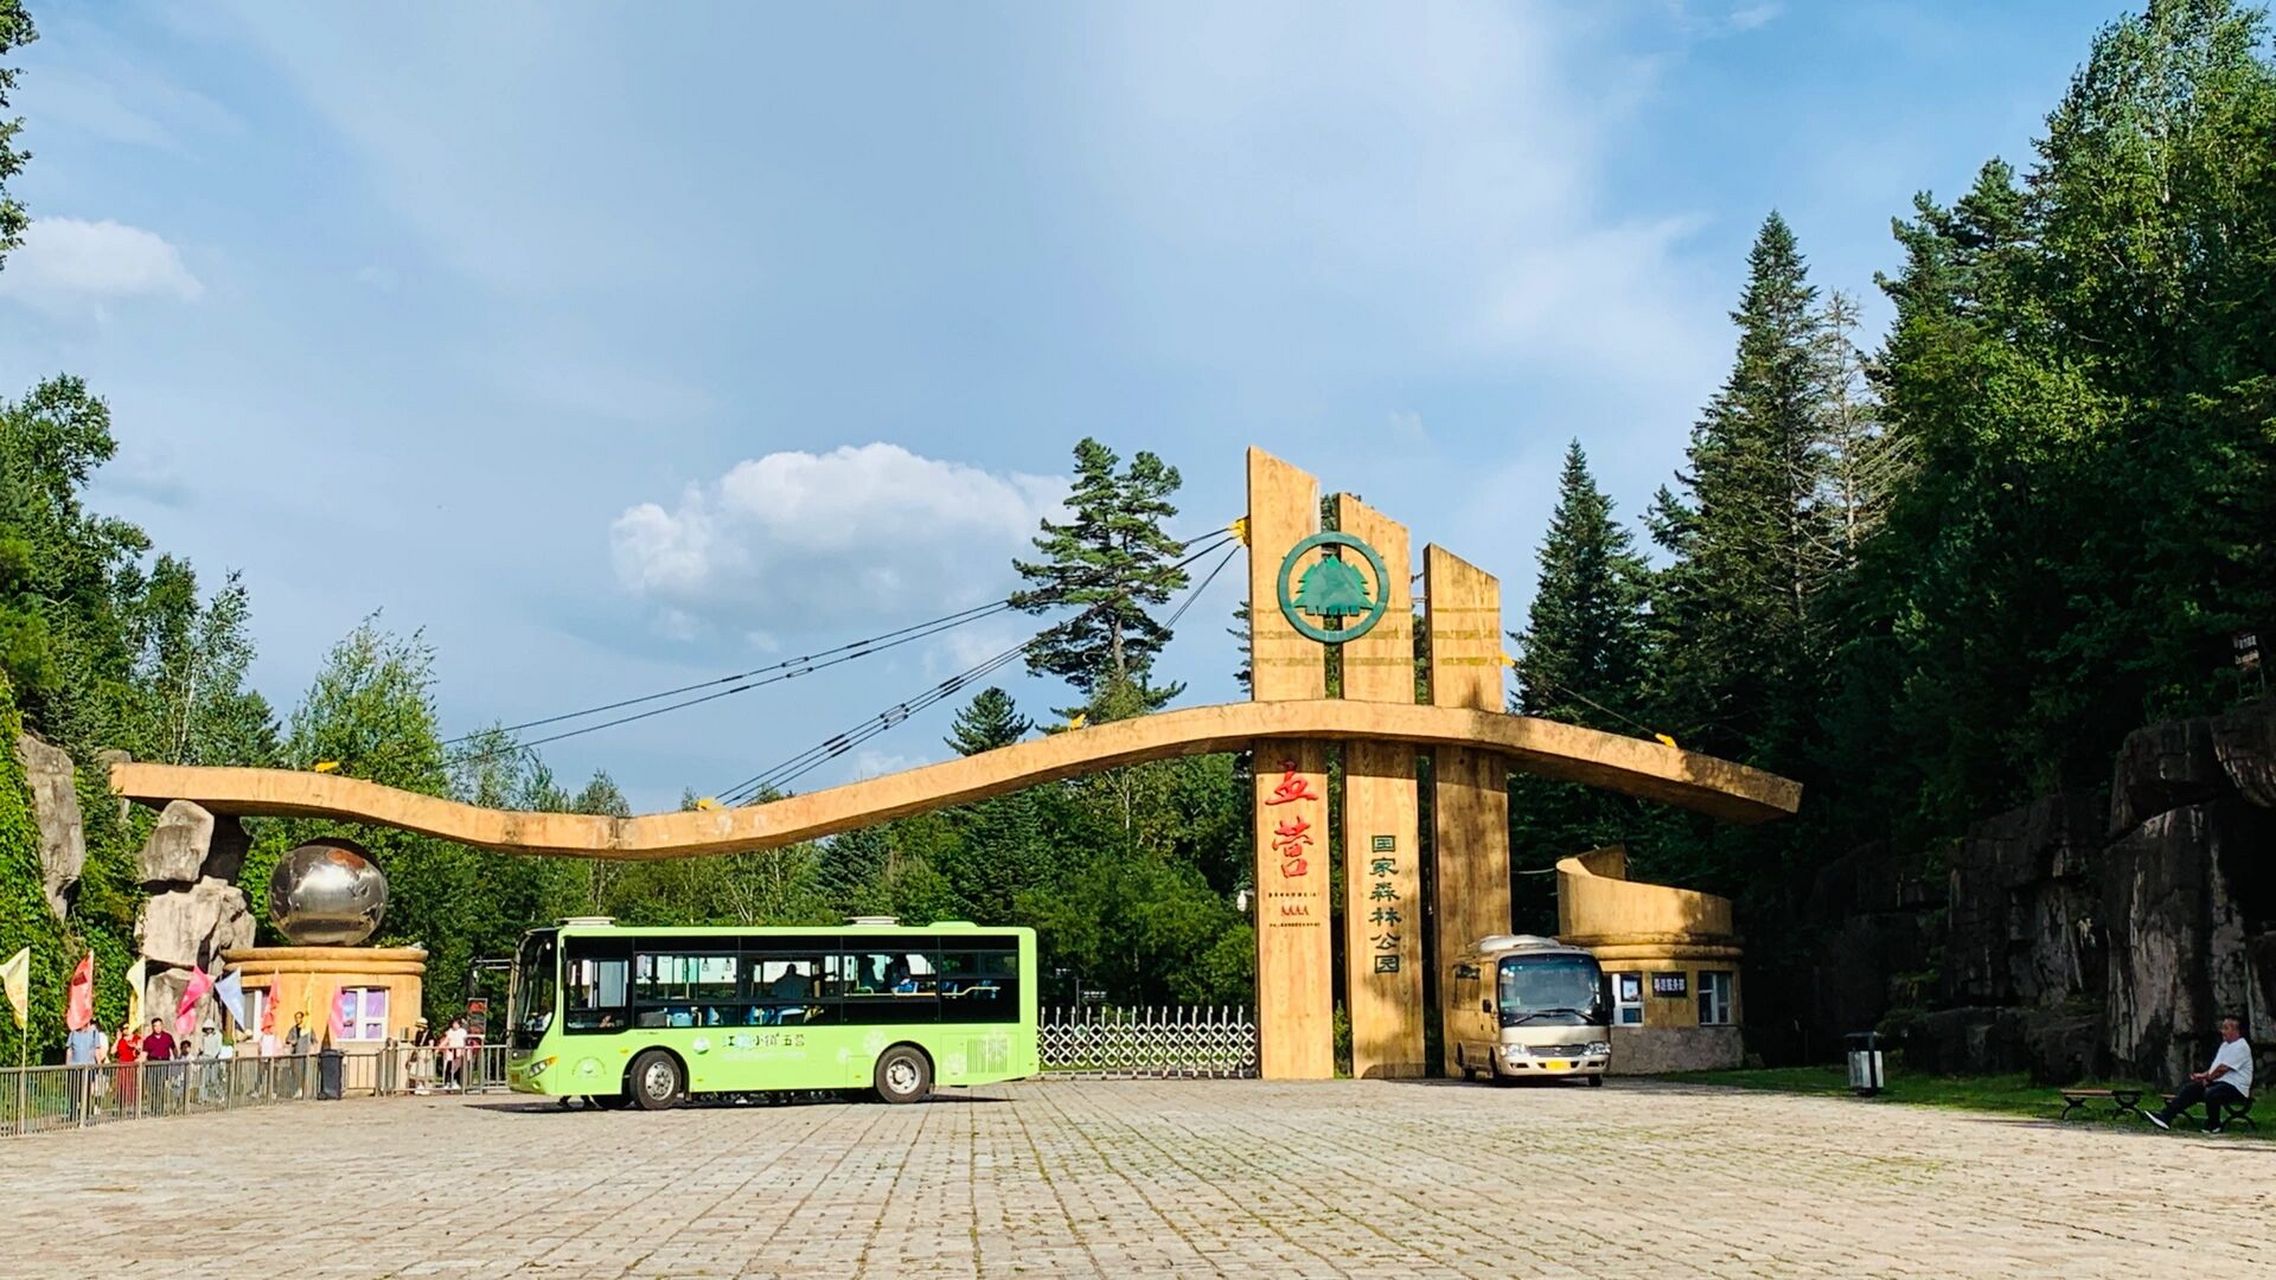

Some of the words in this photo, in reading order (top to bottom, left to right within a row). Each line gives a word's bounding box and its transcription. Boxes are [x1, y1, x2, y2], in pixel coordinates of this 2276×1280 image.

[1265, 759, 1319, 879] 五营
[1368, 835, 1402, 974] 国家森林公园
